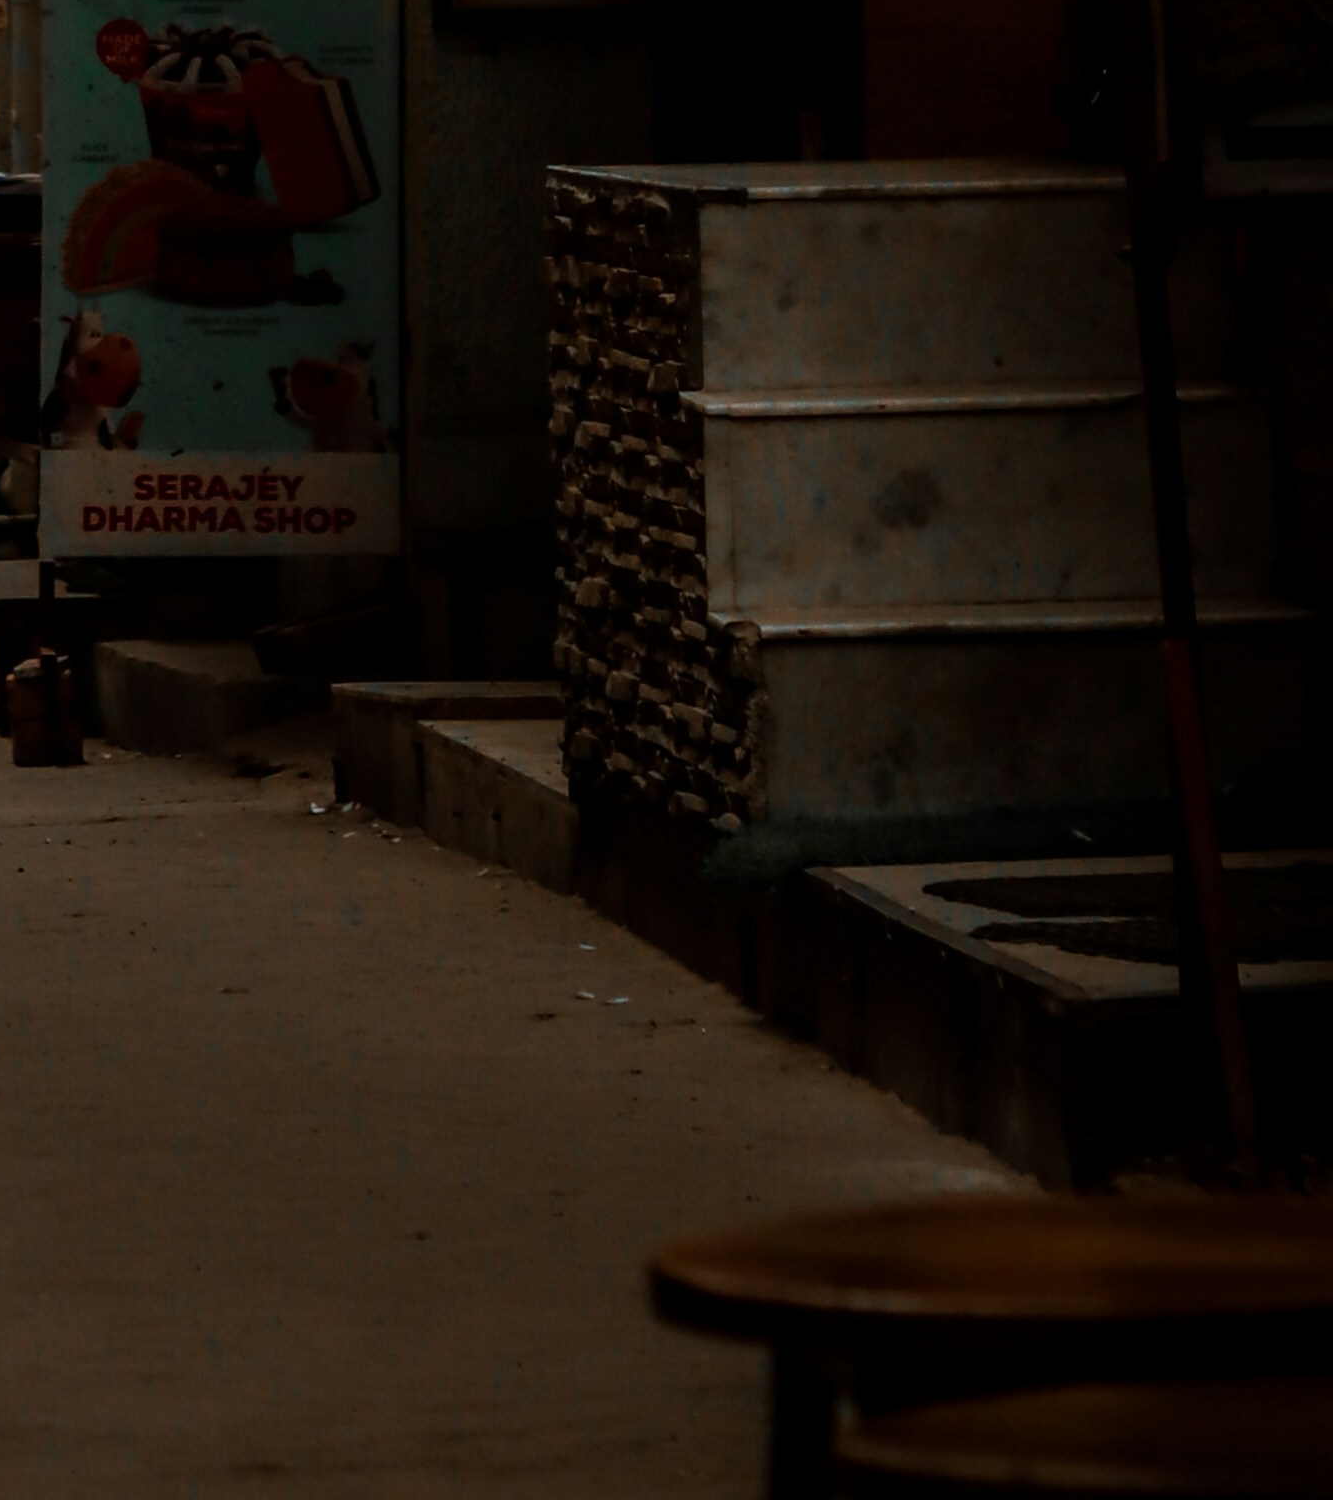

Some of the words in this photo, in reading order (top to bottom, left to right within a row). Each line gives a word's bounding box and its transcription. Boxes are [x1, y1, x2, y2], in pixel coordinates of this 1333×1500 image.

[102, 35, 143, 45] MADE
[106, 54, 140, 65] MILK
[82, 506, 246, 533] DHARMA
[254, 507, 357, 534] SHOP
